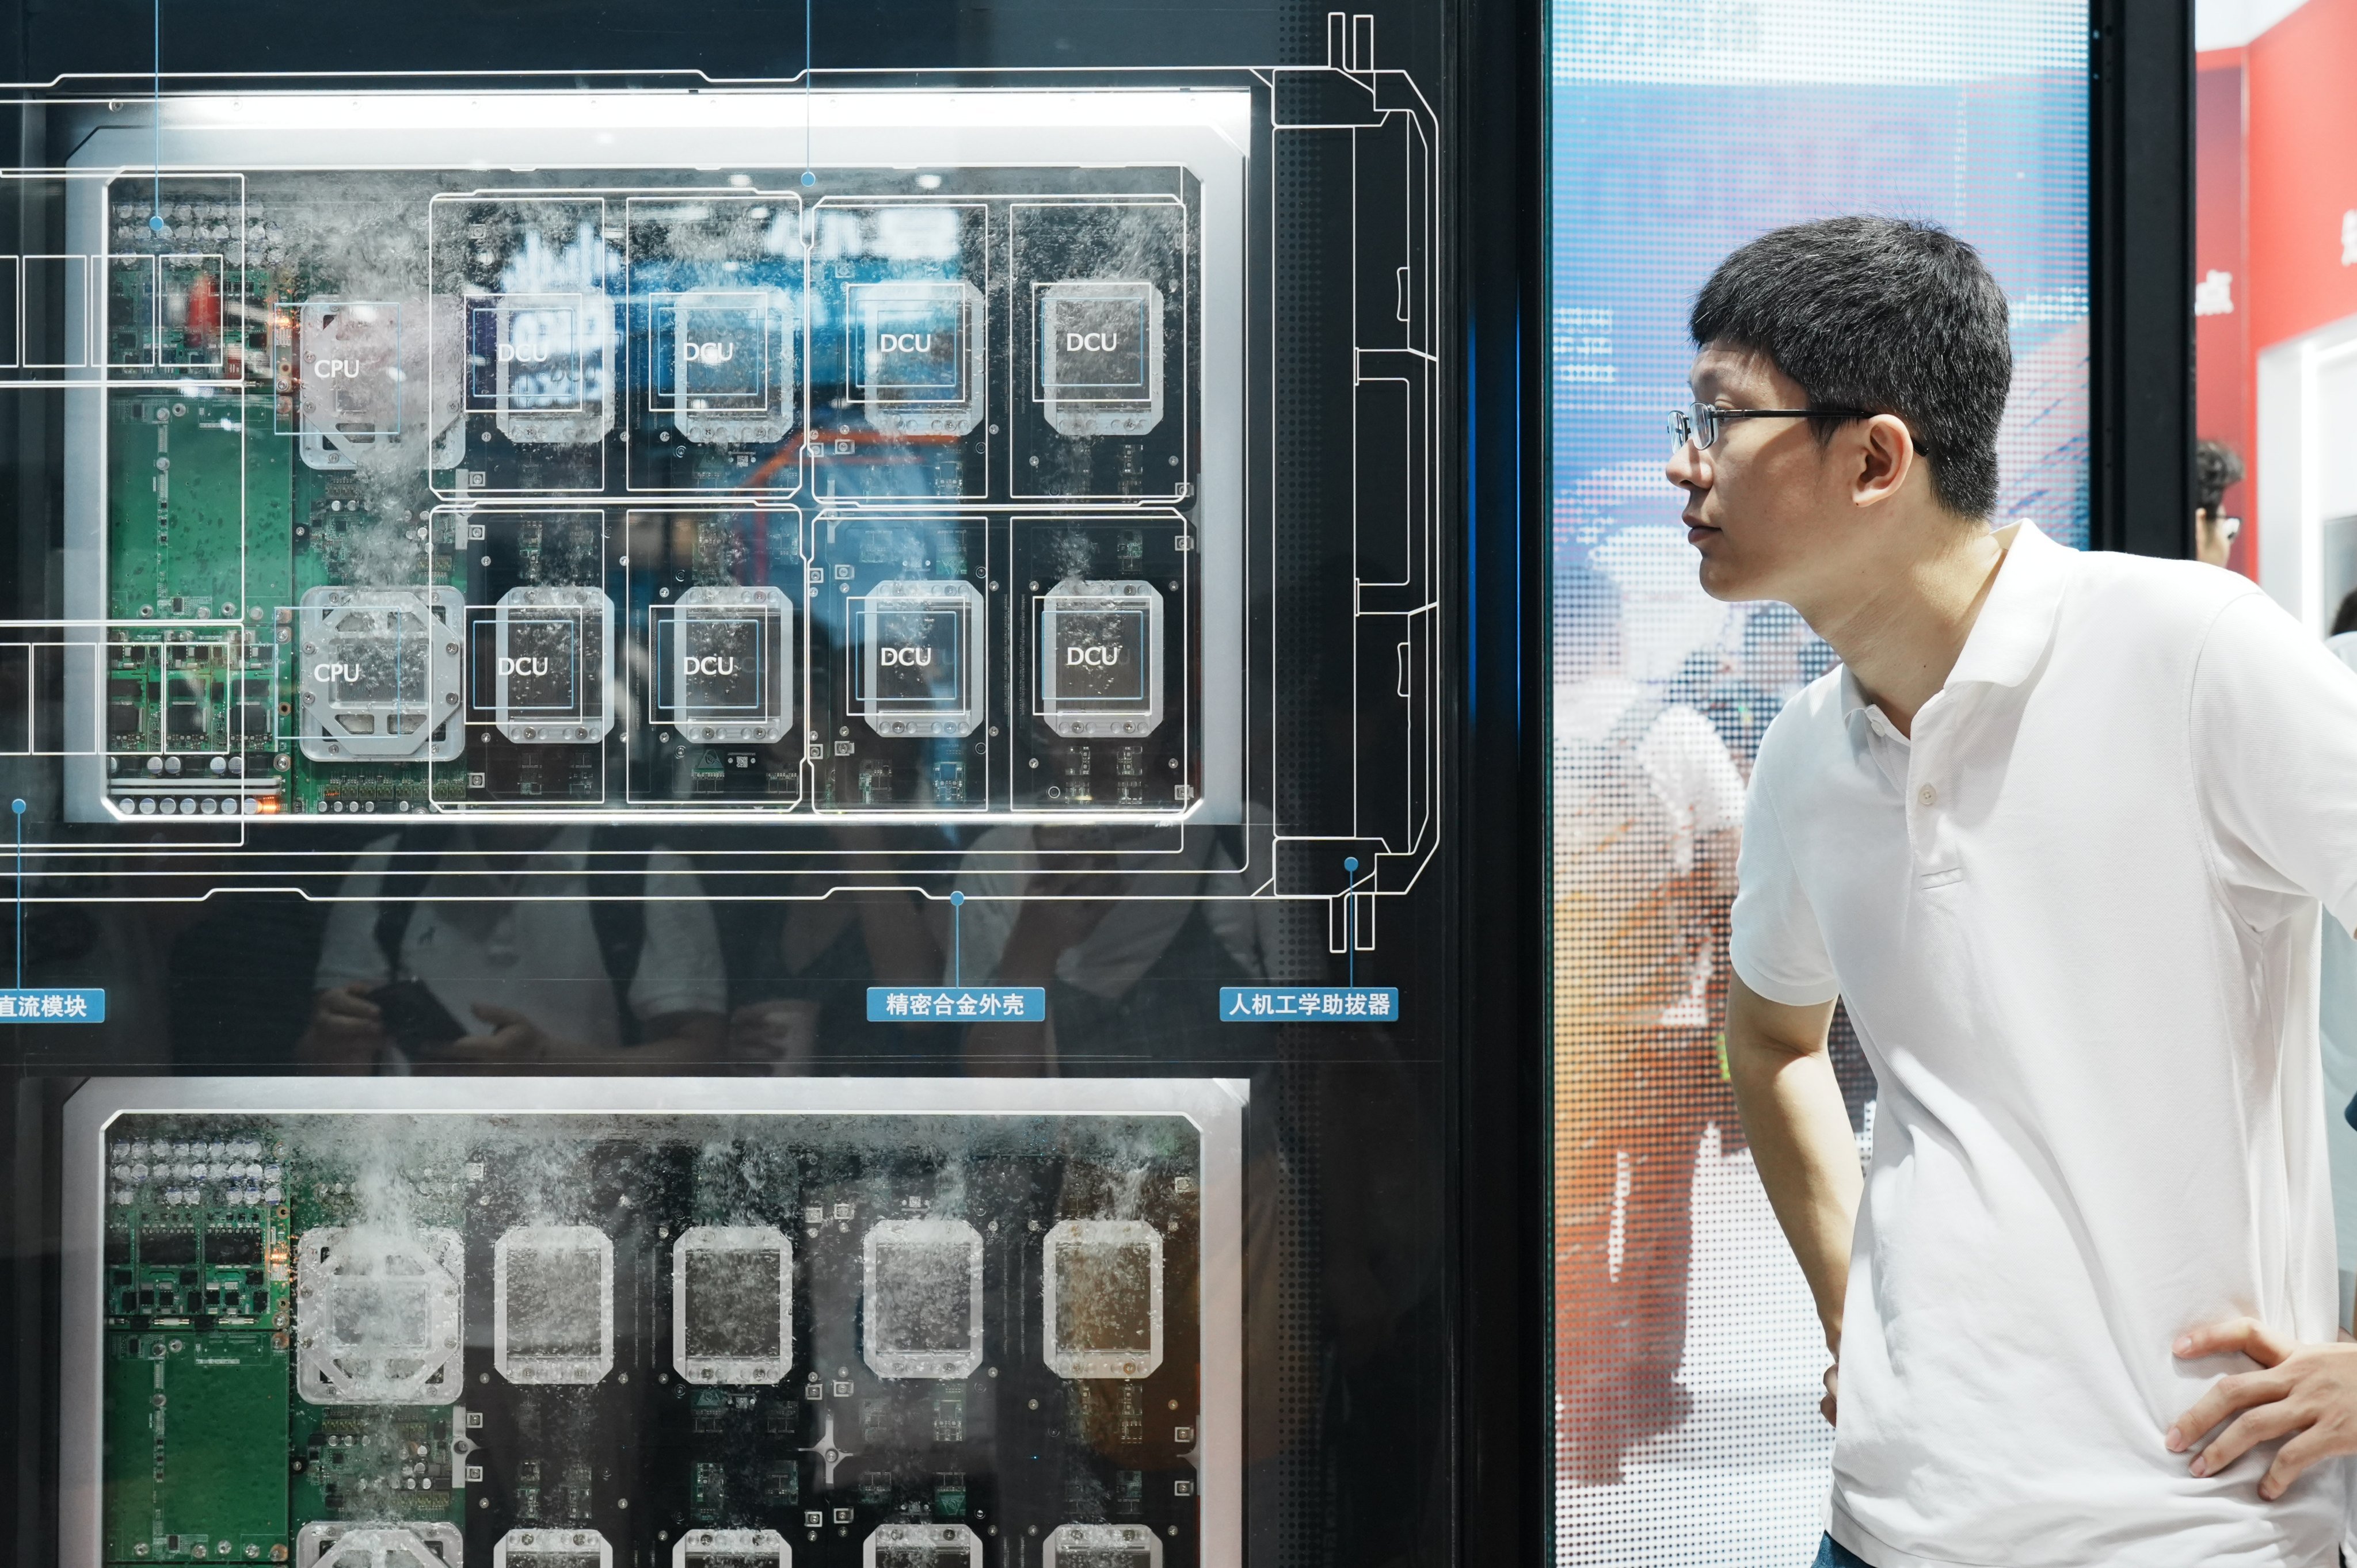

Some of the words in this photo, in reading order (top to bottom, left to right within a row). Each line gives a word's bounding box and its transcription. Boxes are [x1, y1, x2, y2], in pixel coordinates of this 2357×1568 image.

[881, 334, 931, 352] DCU
[1067, 333, 1117, 351] DCU
[498, 344, 548, 362] DCU
[684, 343, 733, 361] DCU
[315, 360, 359, 377] CPU
[881, 648, 931, 665] DCU
[1067, 648, 1117, 665] DCU
[315, 664, 359, 682] CPU
[498, 658, 548, 676] DCU
[684, 657, 734, 675] DCU
[0, 995, 86, 1017] 直流模块
[886, 993, 1024, 1016] 精密合金外壳
[1229, 993, 1391, 1016] 人机工学助拔器
